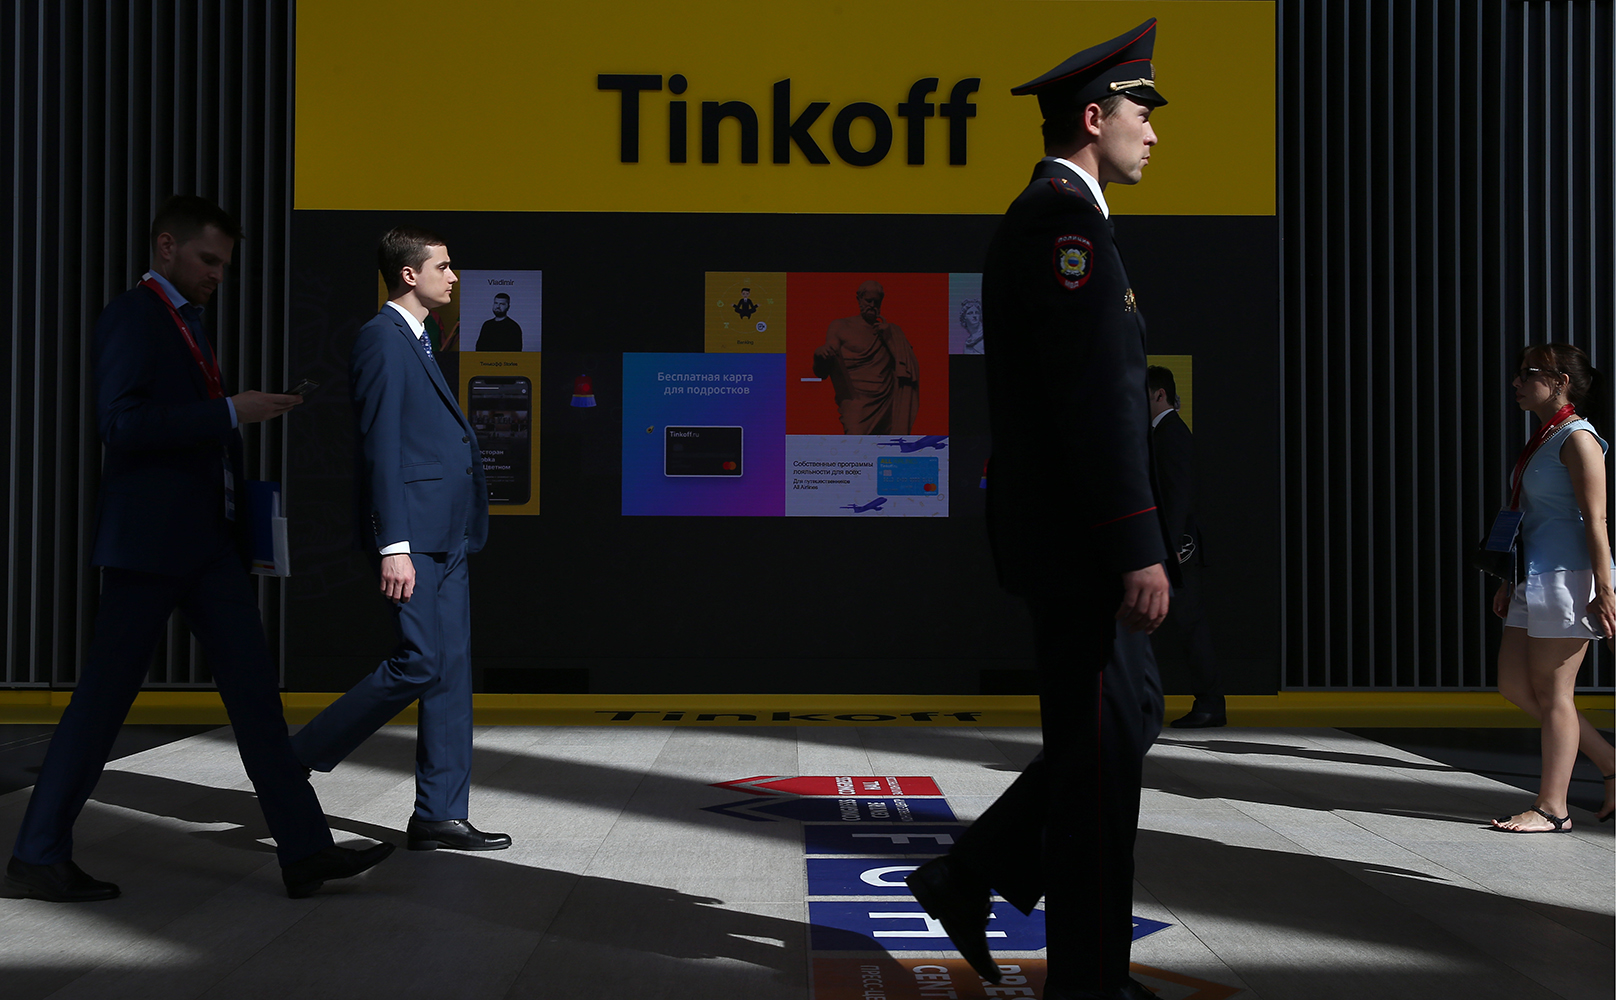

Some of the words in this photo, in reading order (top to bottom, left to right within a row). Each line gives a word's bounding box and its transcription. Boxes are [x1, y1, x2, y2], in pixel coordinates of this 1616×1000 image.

[597, 73, 981, 167] Tinkoff
[1057, 235, 1091, 246] ПОЛИЦИЯ
[487, 278, 515, 286] Vladimir
[657, 371, 720, 383] Бесплатная
[723, 373, 754, 384] карта
[663, 385, 685, 396] для
[686, 386, 751, 397] подростков
[669, 430, 700, 438] Tinkoff.ru
[837, 461, 874, 469] программы
[595, 711, 983, 722] Tinkoff
[838, 798, 861, 822] CONGRESS
[851, 833, 955, 845] F
